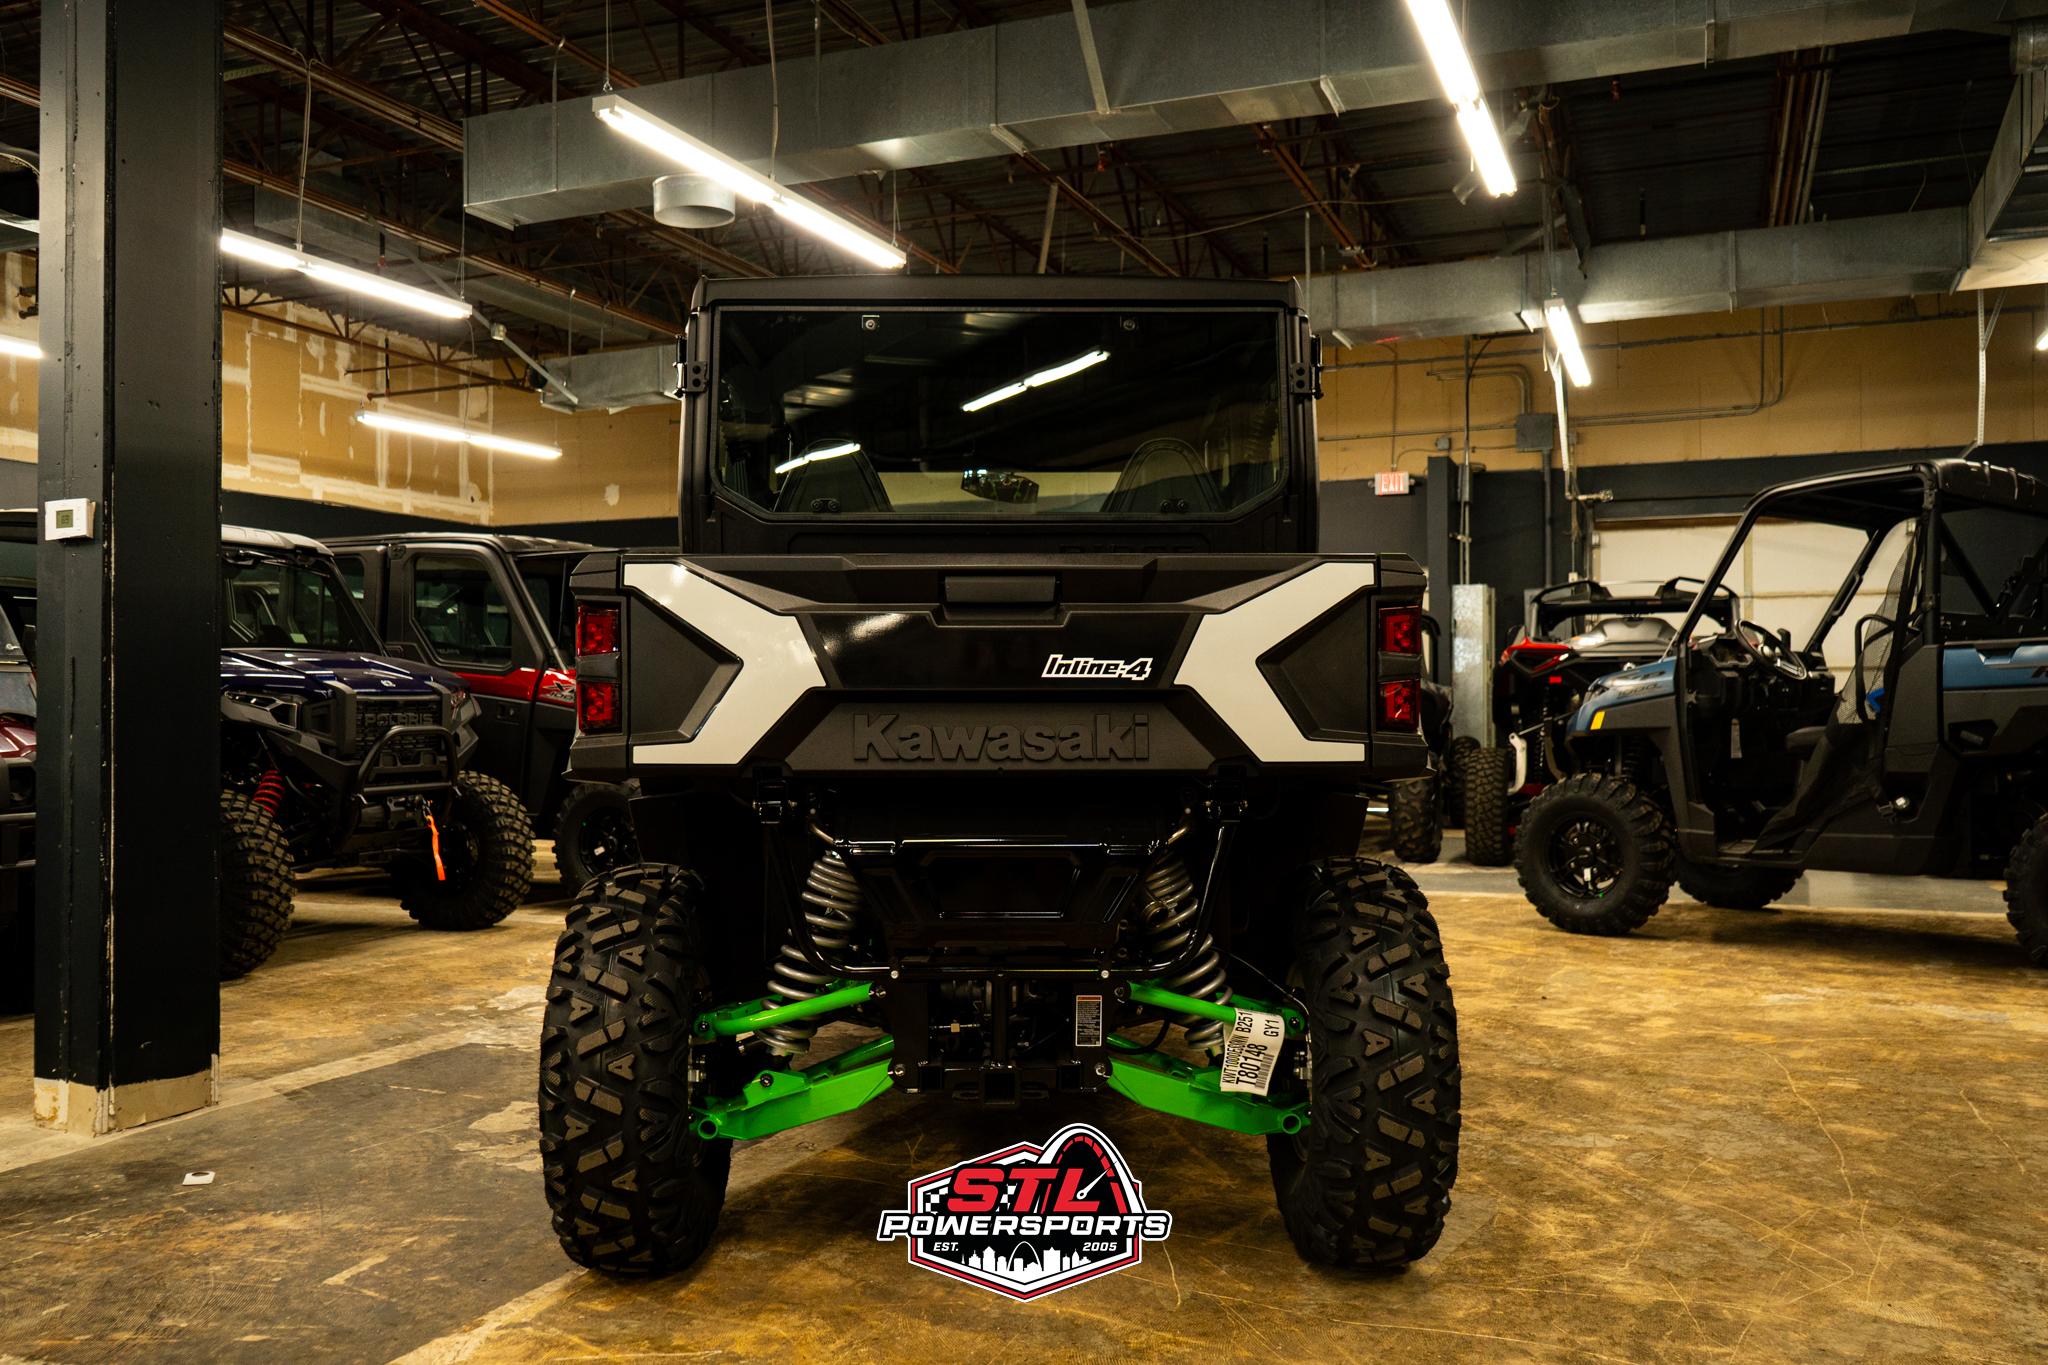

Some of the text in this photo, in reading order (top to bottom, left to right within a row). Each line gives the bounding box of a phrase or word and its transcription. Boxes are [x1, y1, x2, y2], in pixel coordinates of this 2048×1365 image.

[1381, 472, 1406, 493] EXIT
[61, 514, 71, 525] 69
[1042, 653, 1154, 681] Inline-4
[364, 712, 434, 727] POLARIS
[854, 713, 1149, 762] Kawasaki
[1235, 1011, 1254, 1034] B251
[1263, 1019, 1280, 1038] GY1
[1235, 1043, 1268, 1086] T80148
